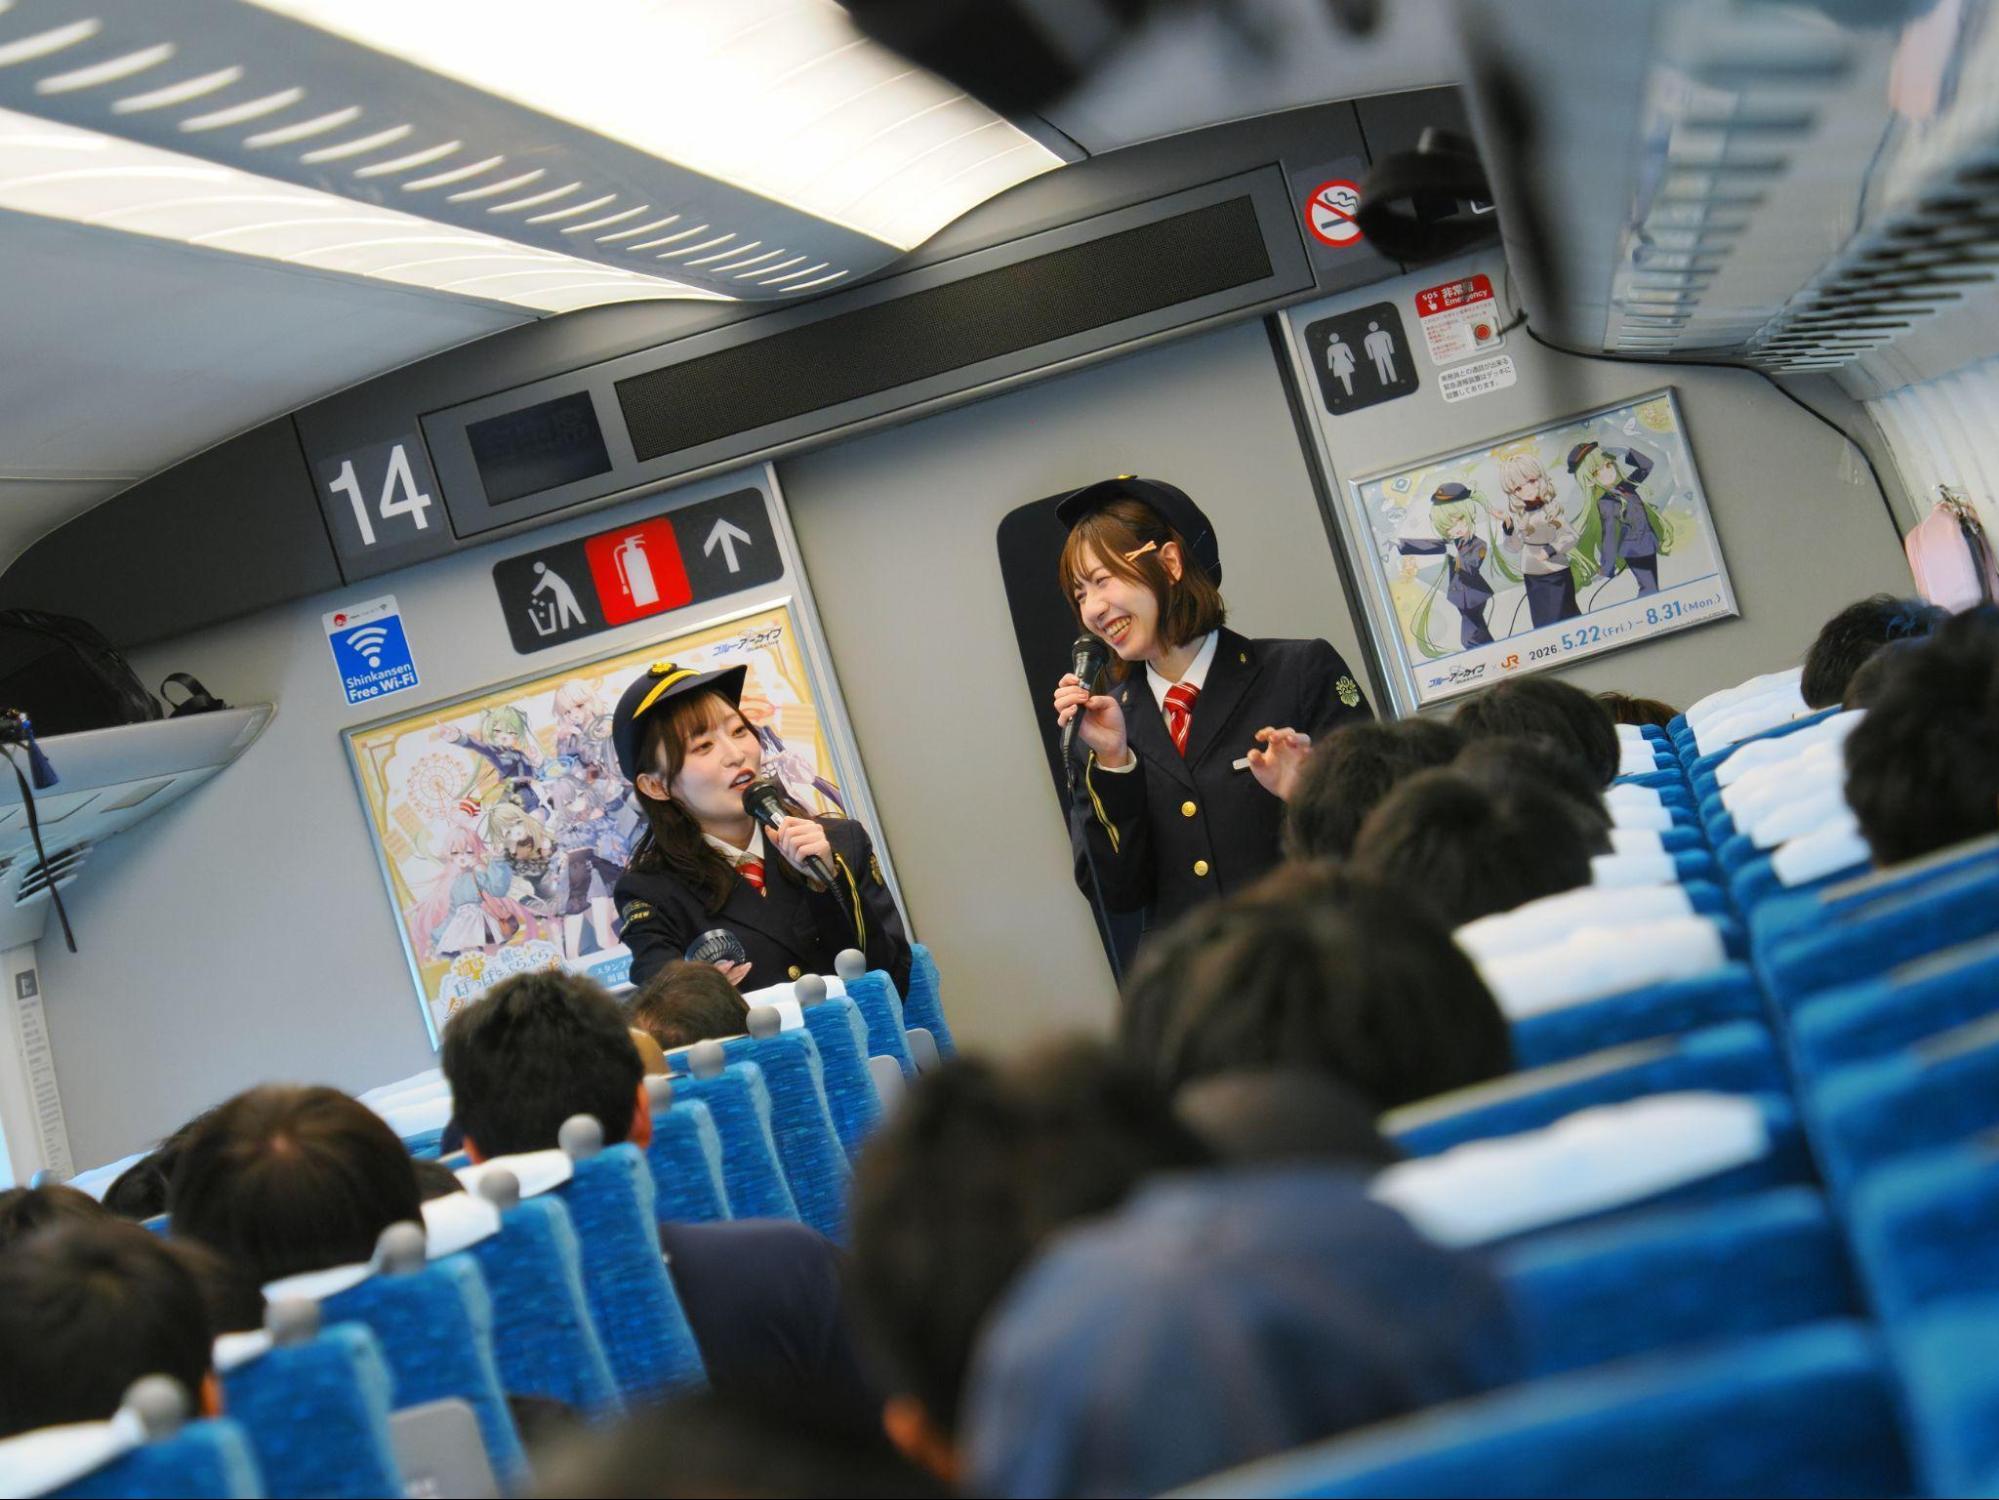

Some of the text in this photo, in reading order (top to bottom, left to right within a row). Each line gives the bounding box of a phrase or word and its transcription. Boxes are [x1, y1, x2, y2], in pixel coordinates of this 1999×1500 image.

[1422, 290, 1439, 301] SOS
[329, 444, 432, 546] 14
[1501, 654, 1520, 669] JR
[346, 663, 412, 689] Shinkansen
[348, 672, 415, 702] Free Wi-Fi
